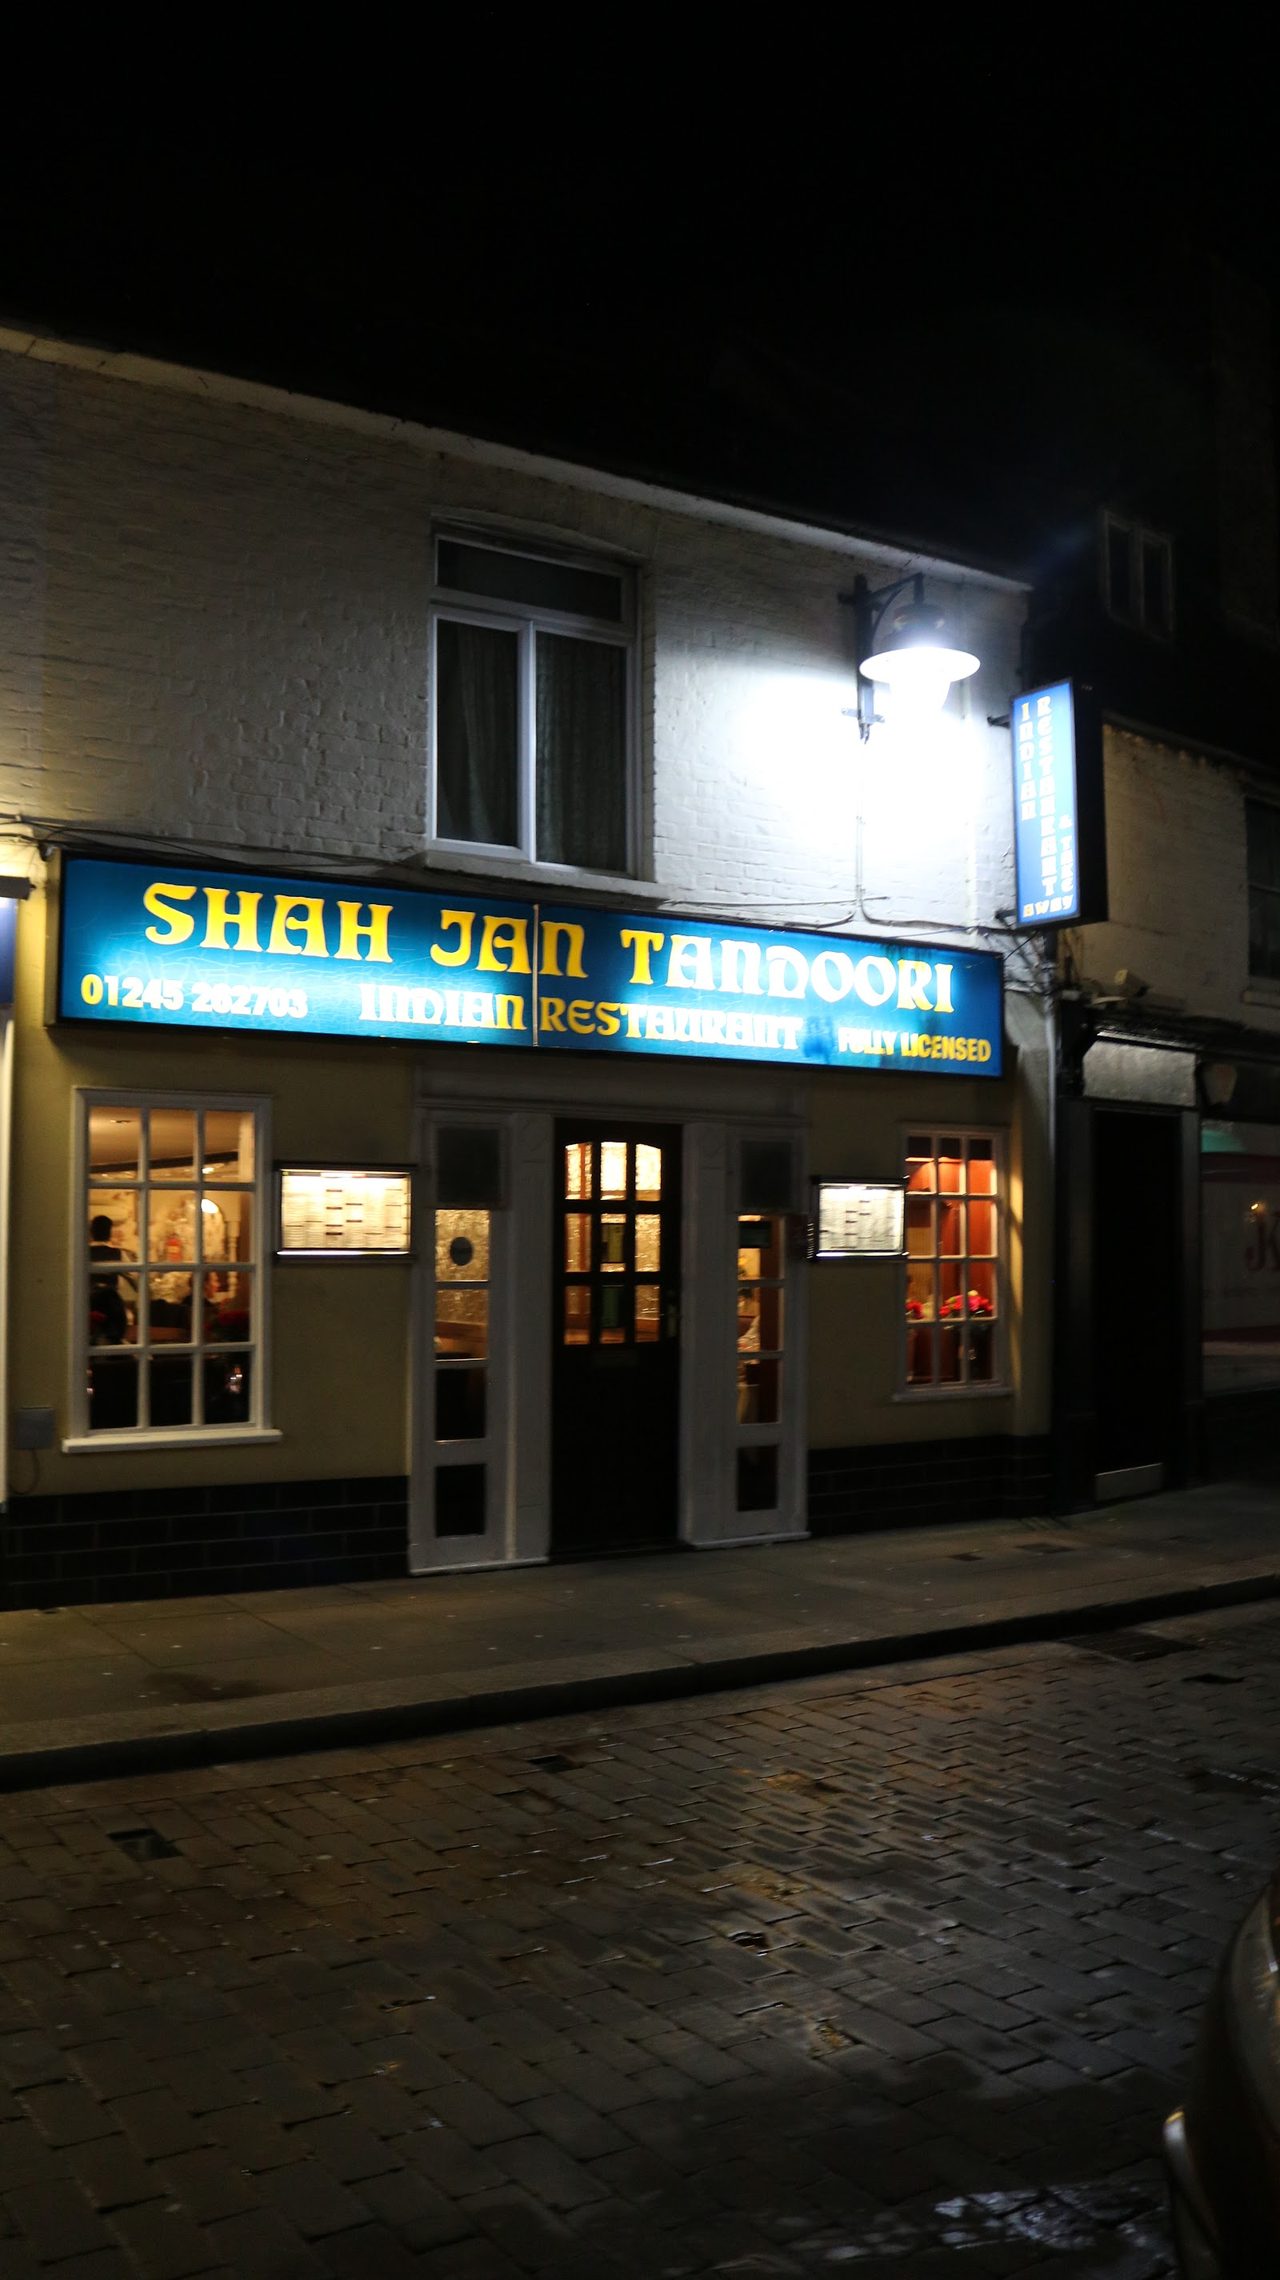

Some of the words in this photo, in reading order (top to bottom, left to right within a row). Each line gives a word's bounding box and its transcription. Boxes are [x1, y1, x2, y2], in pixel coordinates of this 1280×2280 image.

[1018, 702, 1037, 820] INDIAN
[1037, 695, 1057, 896] RESTAURANT
[1060, 835, 1074, 893] TAKE
[143, 882, 393, 963] SHAH
[430, 910, 588, 978] JAN
[620, 929, 955, 1013] TANDOORI
[81, 974, 184, 1010] 01245
[359, 983, 527, 1030] INDIAN
[540, 998, 803, 1050] RESTAURANT
[837, 1026, 897, 1056] FULLY
[900, 1031, 991, 1062] LICENSED
